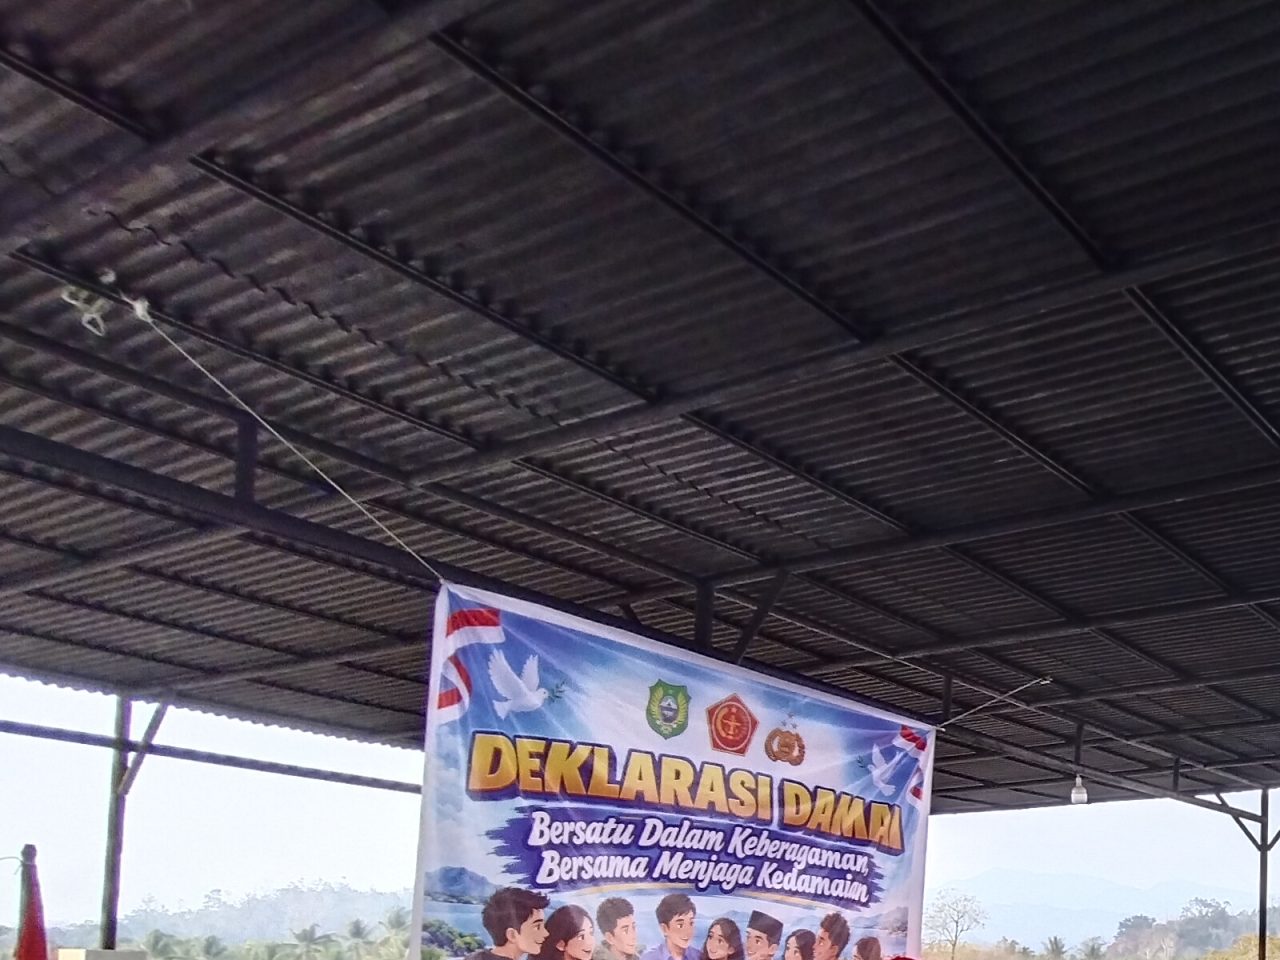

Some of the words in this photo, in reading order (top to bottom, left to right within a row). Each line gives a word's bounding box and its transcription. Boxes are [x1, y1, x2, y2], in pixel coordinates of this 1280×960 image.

[467, 732, 773, 822] DEKLARASI
[782, 779, 904, 851] DAMAI
[528, 811, 635, 846] Bersatu
[638, 818, 725, 851] Dalam
[728, 827, 869, 876] Keberagaman,
[536, 850, 649, 884] Bersama
[652, 851, 754, 890] Menjaga
[756, 861, 870, 902] Kedamaian
